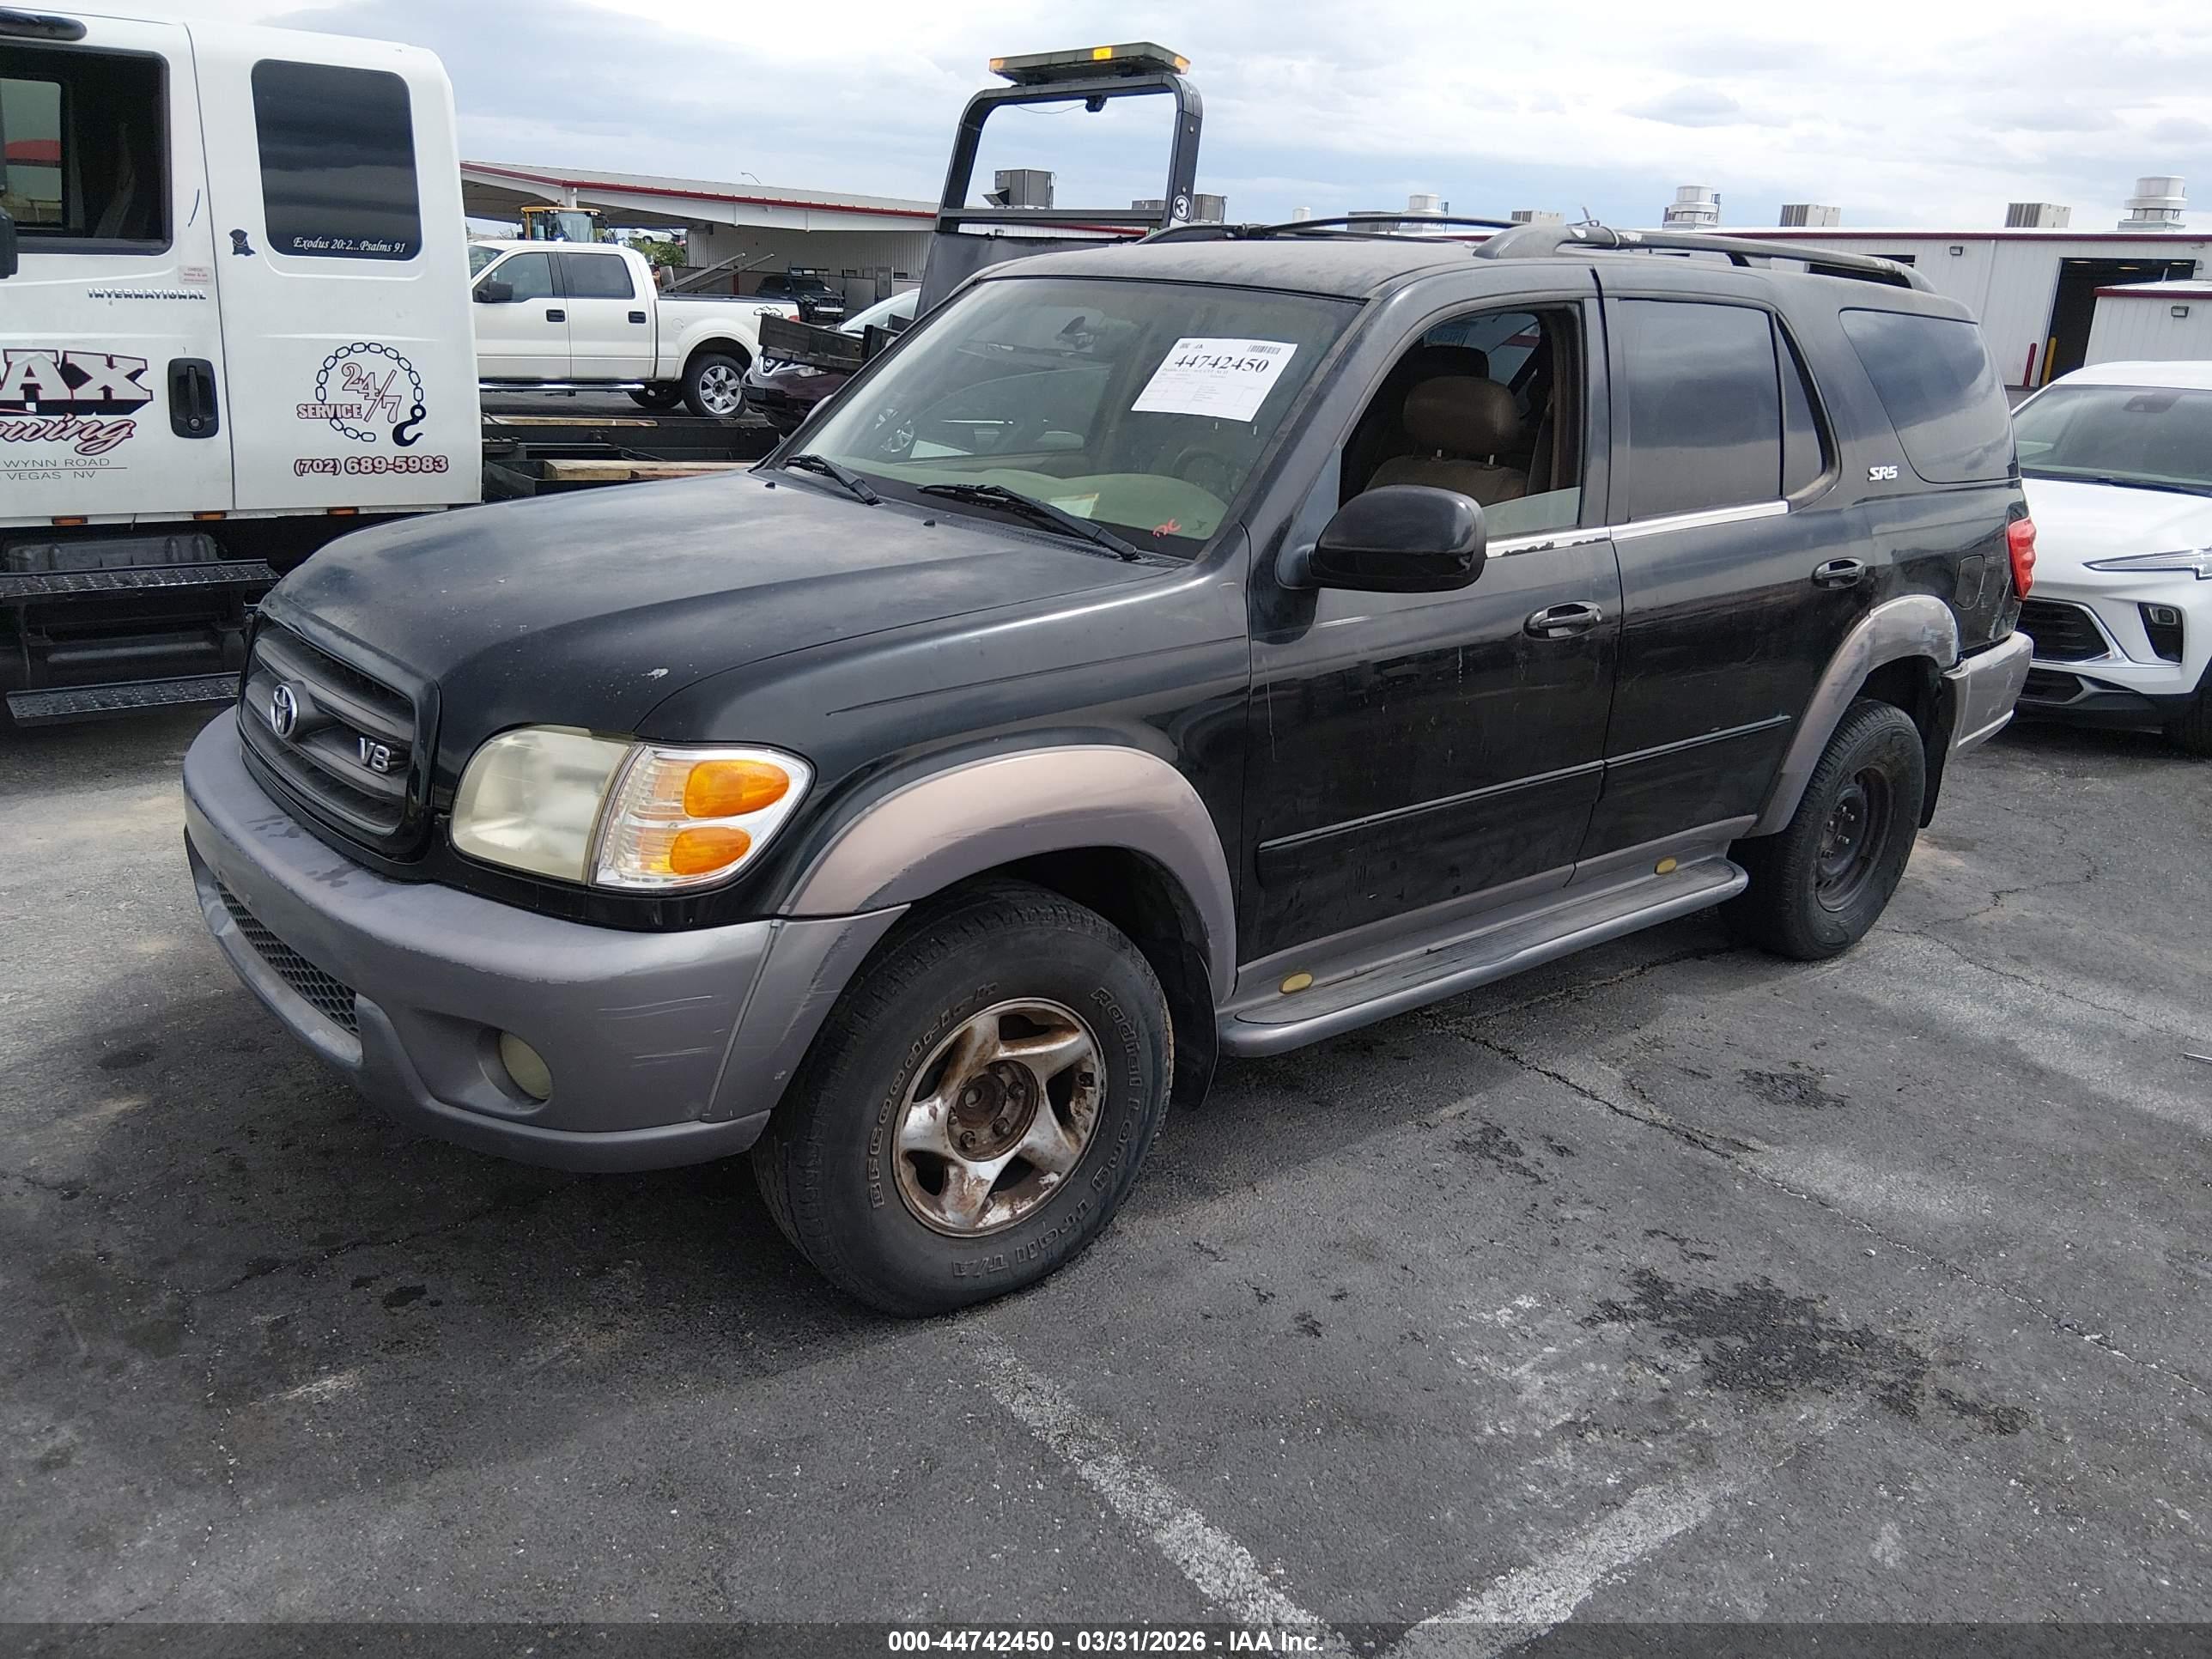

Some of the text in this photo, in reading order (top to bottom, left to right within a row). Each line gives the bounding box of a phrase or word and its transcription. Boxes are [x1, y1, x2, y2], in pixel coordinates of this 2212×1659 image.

[1176, 198, 1188, 216] 3
[293, 236, 329, 250] Exodus
[394, 242, 406, 252] 91
[88, 288, 207, 301] INTERNATIONAL
[1175, 355, 1270, 374] 44742450
[0, 349, 154, 416] AX
[341, 362, 402, 423] 24/7
[296, 404, 362, 419] SERVICE
[3, 458, 111, 469] WYNN ROAD
[294, 455, 449, 477] (702) 689-5983
[7, 470, 96, 481] VEGAS NV
[1868, 465, 1899, 482] SR5
[358, 736, 391, 773] V8
[1091, 987, 1143, 1087] Radial
[951, 1254, 1011, 1278] T/A
